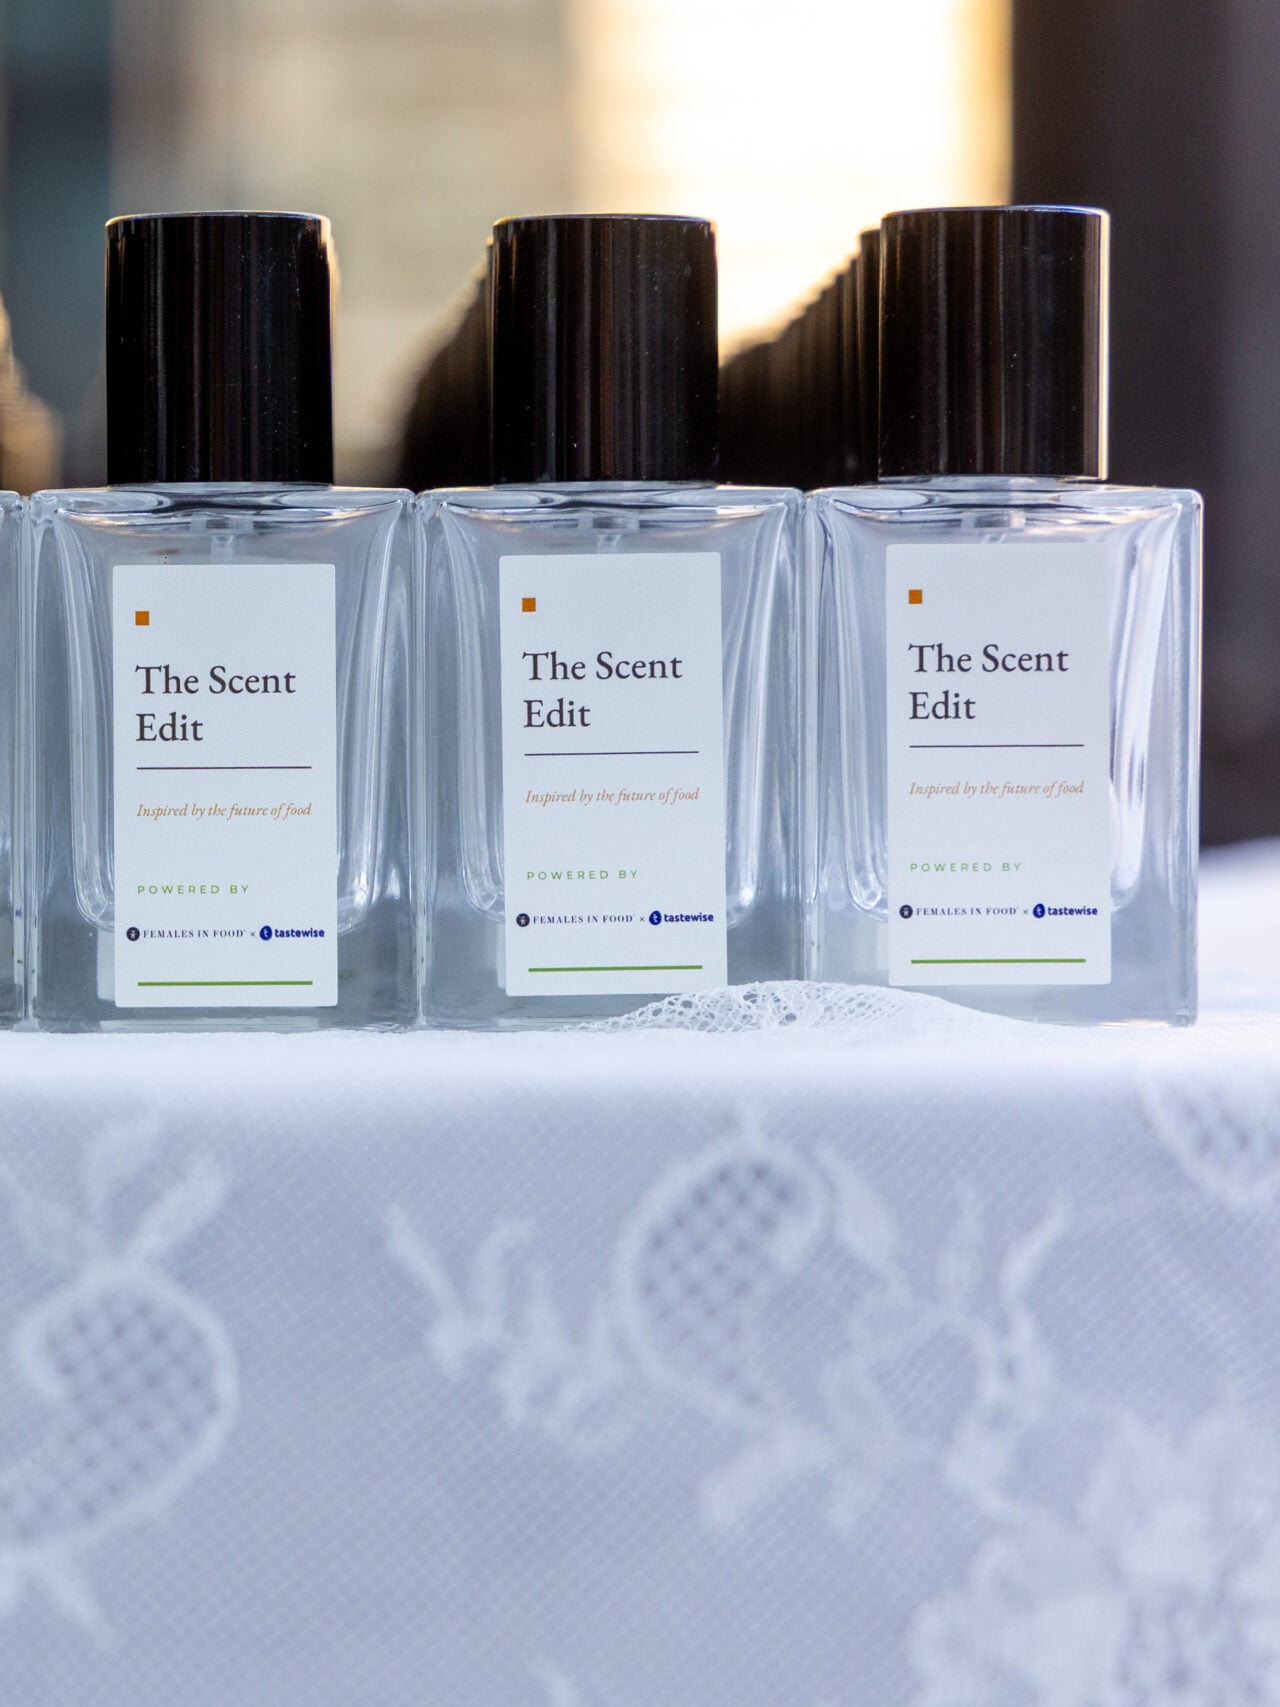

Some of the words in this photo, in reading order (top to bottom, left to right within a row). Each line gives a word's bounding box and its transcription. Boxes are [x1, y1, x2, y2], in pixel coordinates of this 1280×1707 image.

[521, 650, 586, 681] The
[596, 651, 683, 680] Scent
[907, 642, 972, 672] The
[981, 643, 1069, 672] Scent
[135, 664, 199, 695] The
[209, 666, 296, 695] Scent
[523, 698, 591, 728] Edit
[908, 689, 976, 720] Edit
[135, 711, 203, 742] Edit
[525, 788, 577, 808] Inspired
[579, 788, 594, 806] by
[596, 788, 615, 802] the
[614, 788, 657, 806] future
[658, 787, 674, 805] of
[669, 787, 700, 805] food
[909, 781, 961, 799] Inspired
[963, 781, 978, 798] by
[980, 781, 1000, 794] the
[999, 781, 1041, 798] future
[1043, 780, 1059, 798] of
[1054, 780, 1085, 798] food
[136, 803, 189, 821] Inspired
[191, 803, 206, 821] by
[208, 803, 227, 817] the
[225, 802, 269, 820] future
[270, 802, 286, 820] of
[281, 802, 313, 820] food
[527, 870, 609, 881] POWERED
[618, 869, 638, 880] BY
[910, 862, 992, 872] POWERED
[1002, 862, 1021, 872] BY
[137, 884, 220, 895] POWERED
[229, 884, 249, 894] BY
[532, 914, 583, 925] FEMALES
[587, 915, 598, 923] IN
[663, 912, 714, 923] tastewise
[916, 907, 967, 916] FEMALES
[970, 907, 982, 915] IN
[1047, 905, 1098, 916] tastewise
[143, 929, 194, 939] FEMALES
[197, 930, 208, 938] IN
[274, 927, 325, 938] tastewise
